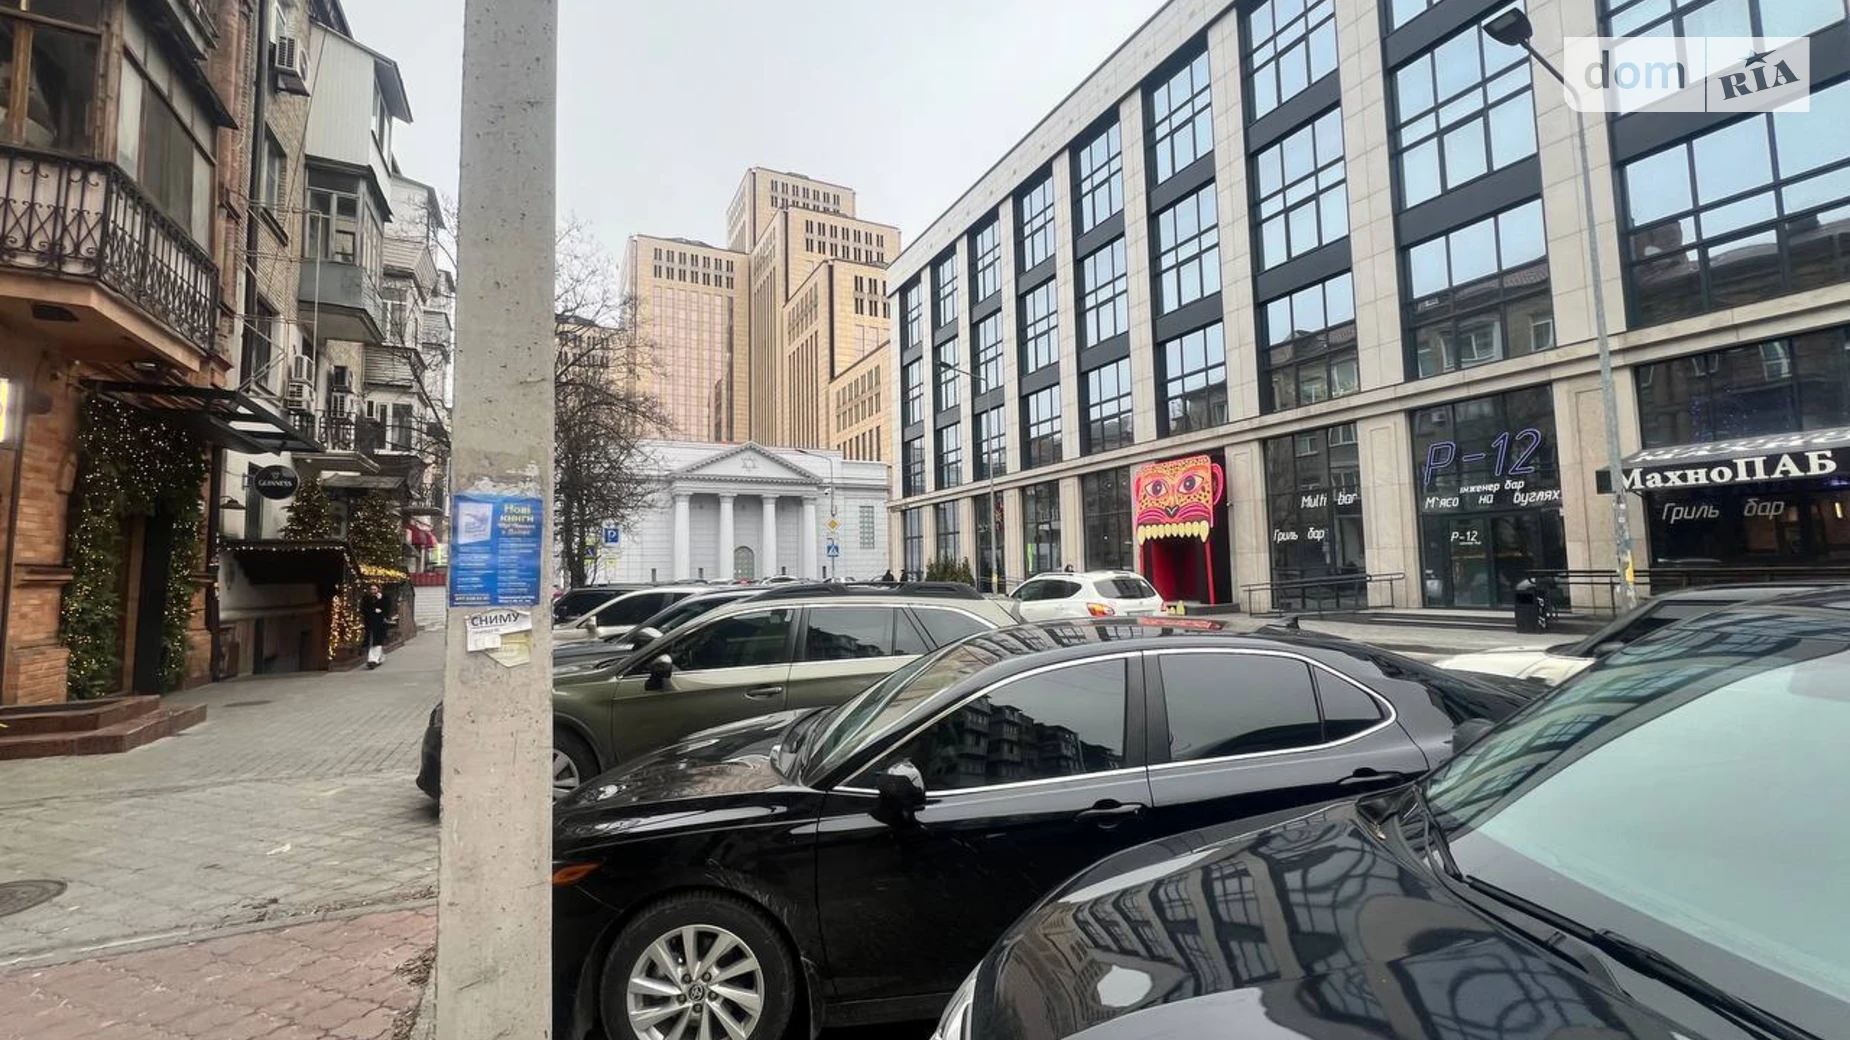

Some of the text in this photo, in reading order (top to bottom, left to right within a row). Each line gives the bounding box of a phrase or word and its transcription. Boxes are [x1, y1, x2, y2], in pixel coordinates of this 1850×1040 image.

[1621, 449, 1838, 491] МахноПАБ
[1504, 479, 1525, 491] бар
[1300, 491, 1358, 508] Multi bar
[1478, 494, 1494, 504] на
[1662, 497, 1785, 525] Гриль бар
[1273, 526, 1326, 544] Гриль бар
[470, 612, 520, 627] СНИМУ
